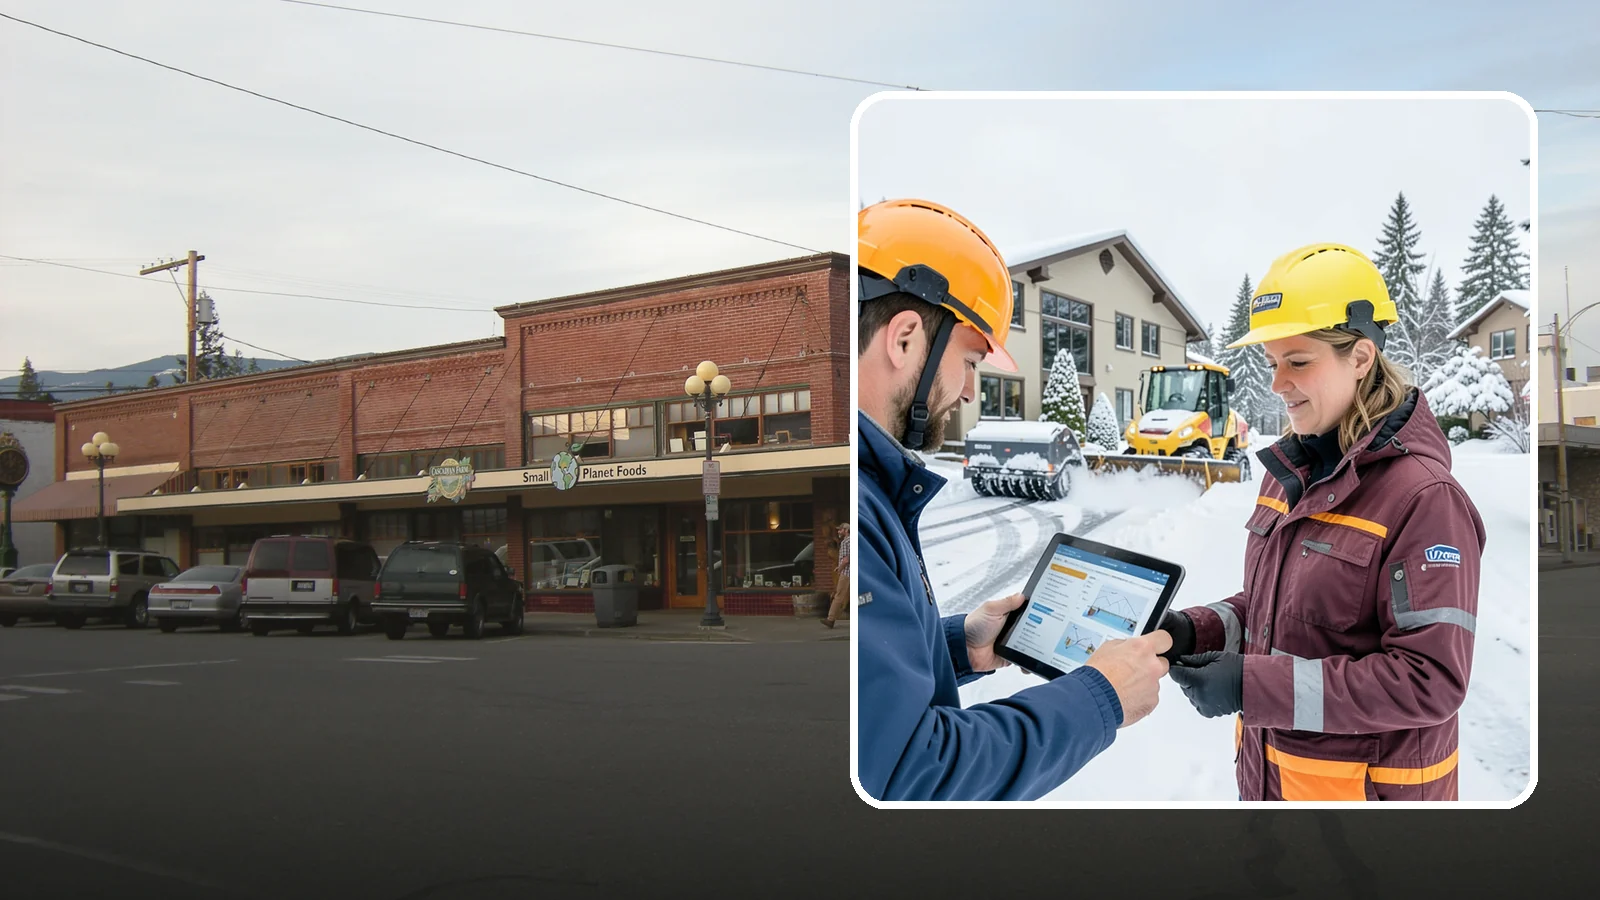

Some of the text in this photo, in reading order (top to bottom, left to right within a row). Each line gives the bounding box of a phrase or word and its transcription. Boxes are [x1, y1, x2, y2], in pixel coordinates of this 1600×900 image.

[523, 464, 647, 483] Small Planet Foods
